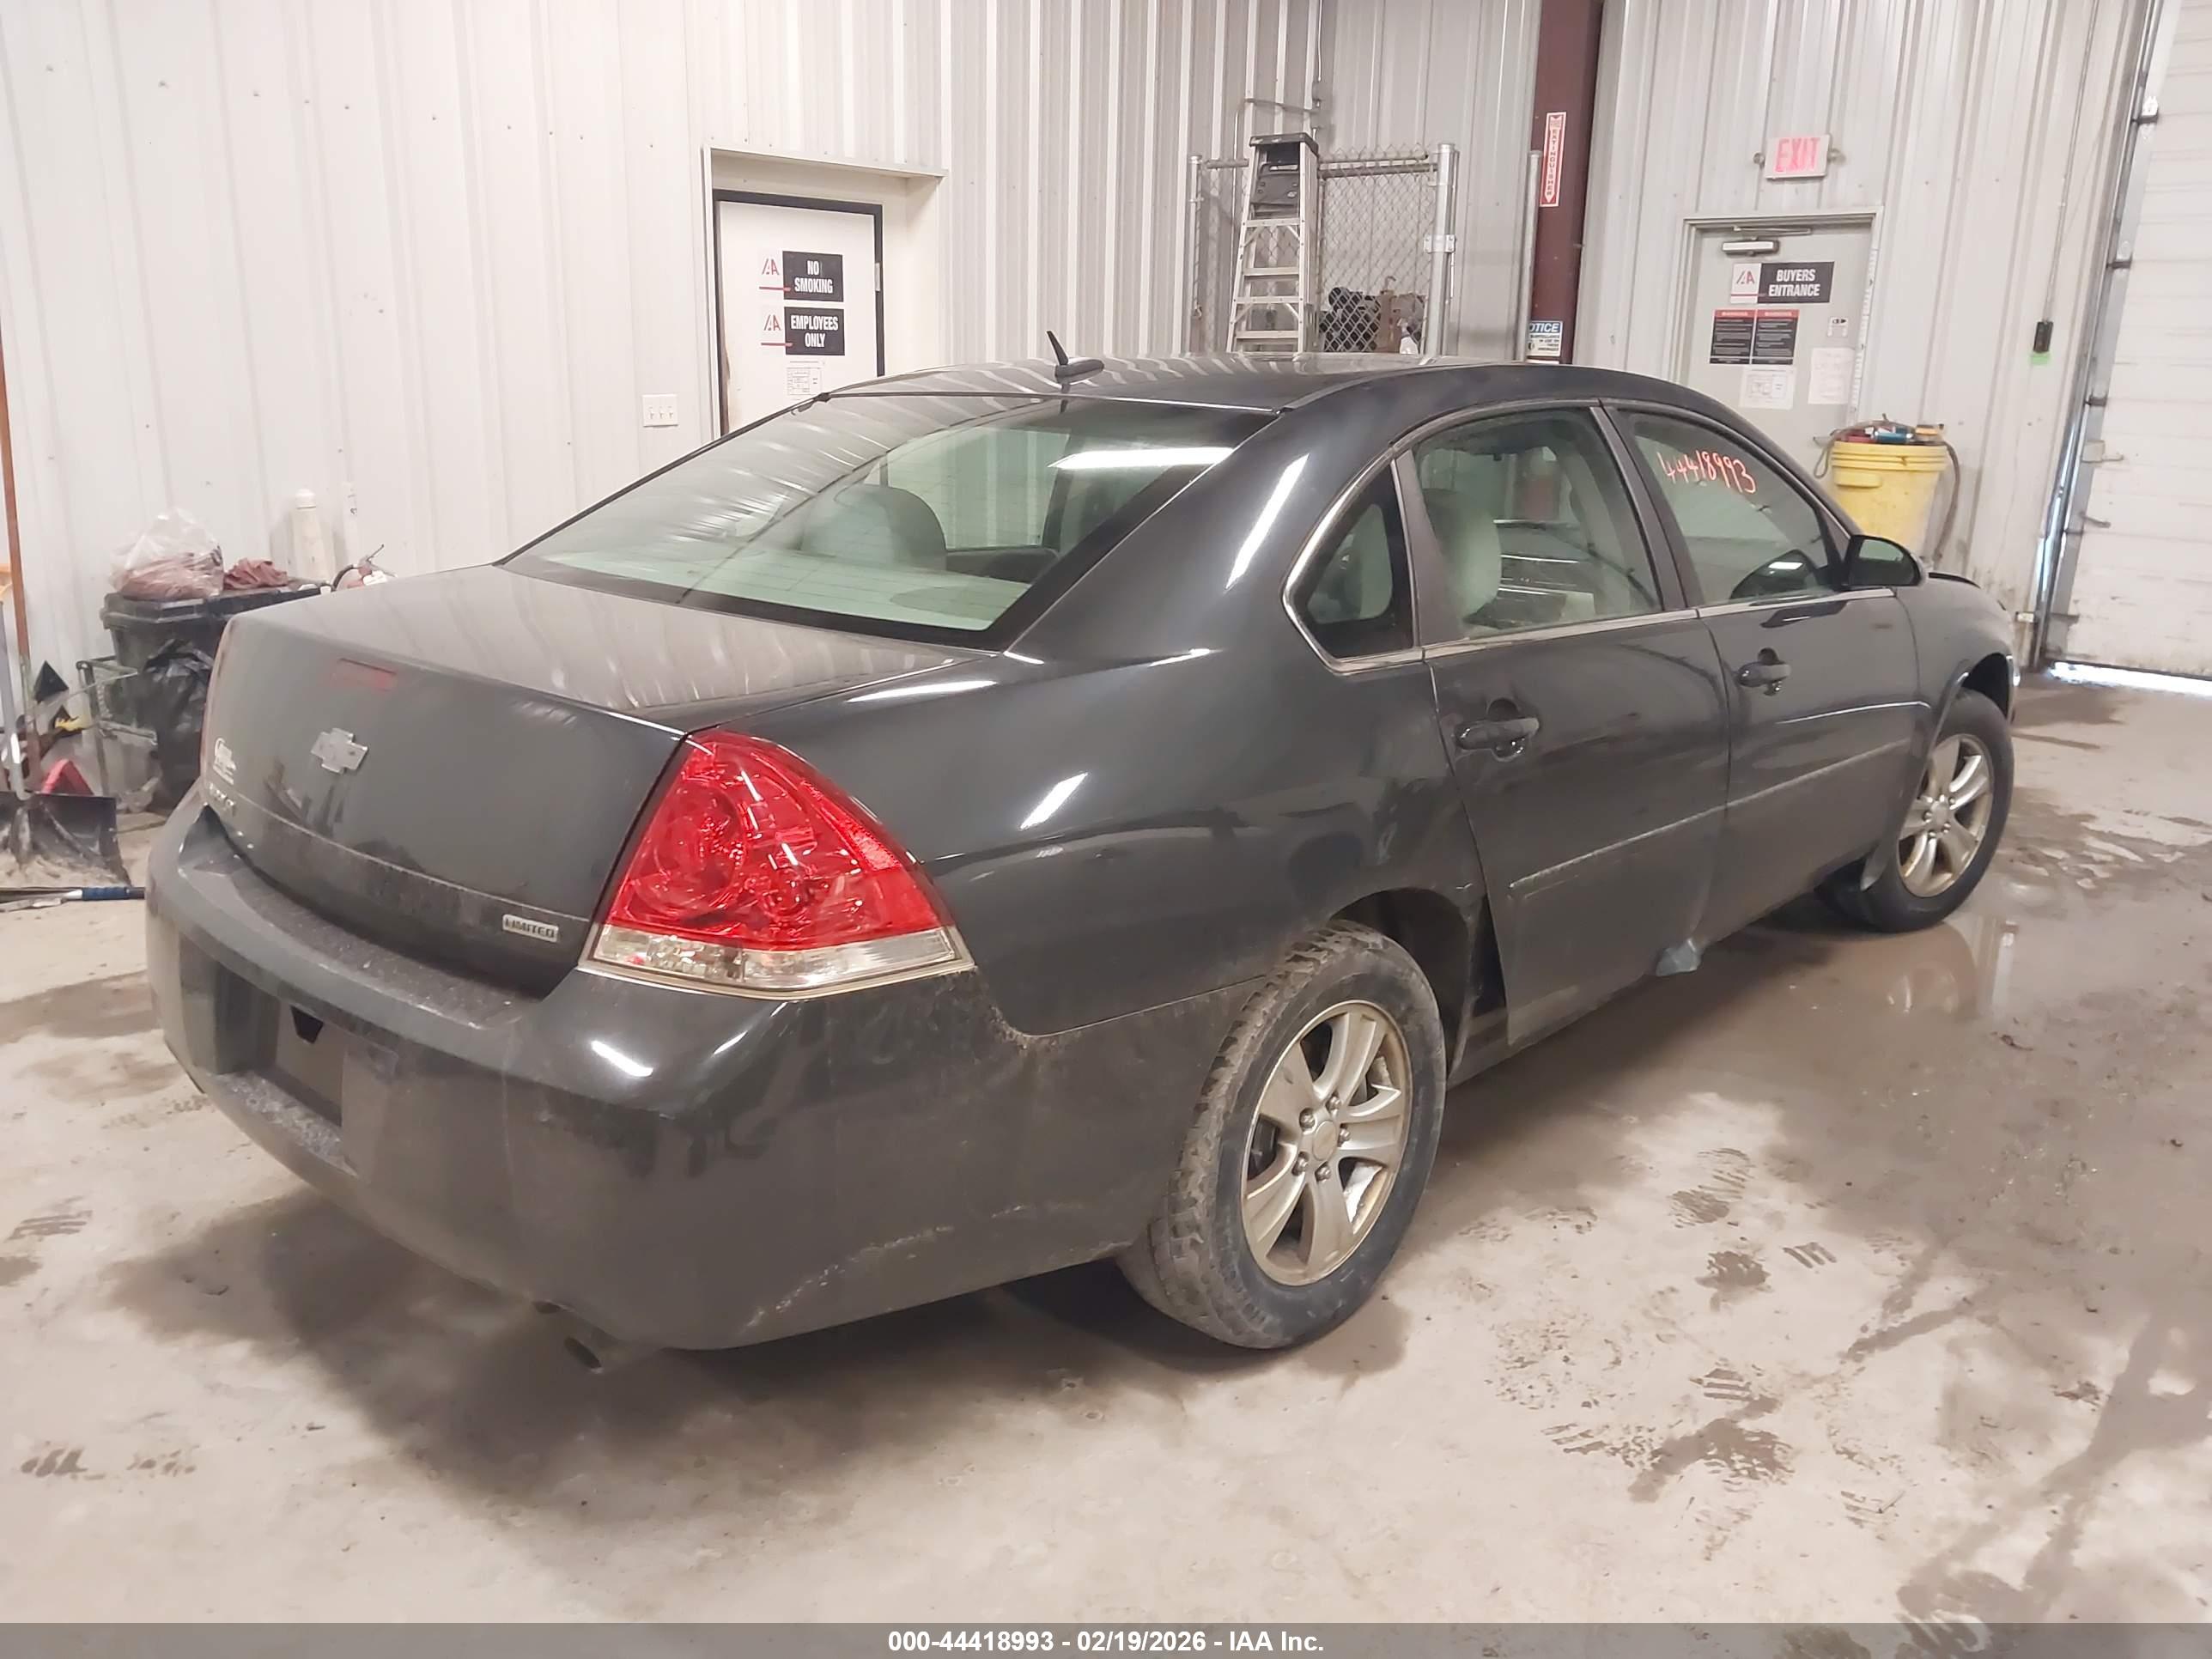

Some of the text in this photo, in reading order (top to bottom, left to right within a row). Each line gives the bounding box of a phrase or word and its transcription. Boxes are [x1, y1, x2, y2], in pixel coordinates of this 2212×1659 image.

[1775, 137, 1820, 173] EXIT
[806, 259, 820, 276] NO
[1776, 268, 1816, 283] BUYERS
[793, 276, 834, 294] SMOKING
[1768, 283, 1821, 297] ENTRANCE
[790, 314, 839, 331] EMPLOYEES
[1528, 322, 1560, 333] OTICE
[804, 332, 826, 348] ONLY
[1656, 449, 1756, 494] 44418993
[504, 917, 556, 939] LIMITED
